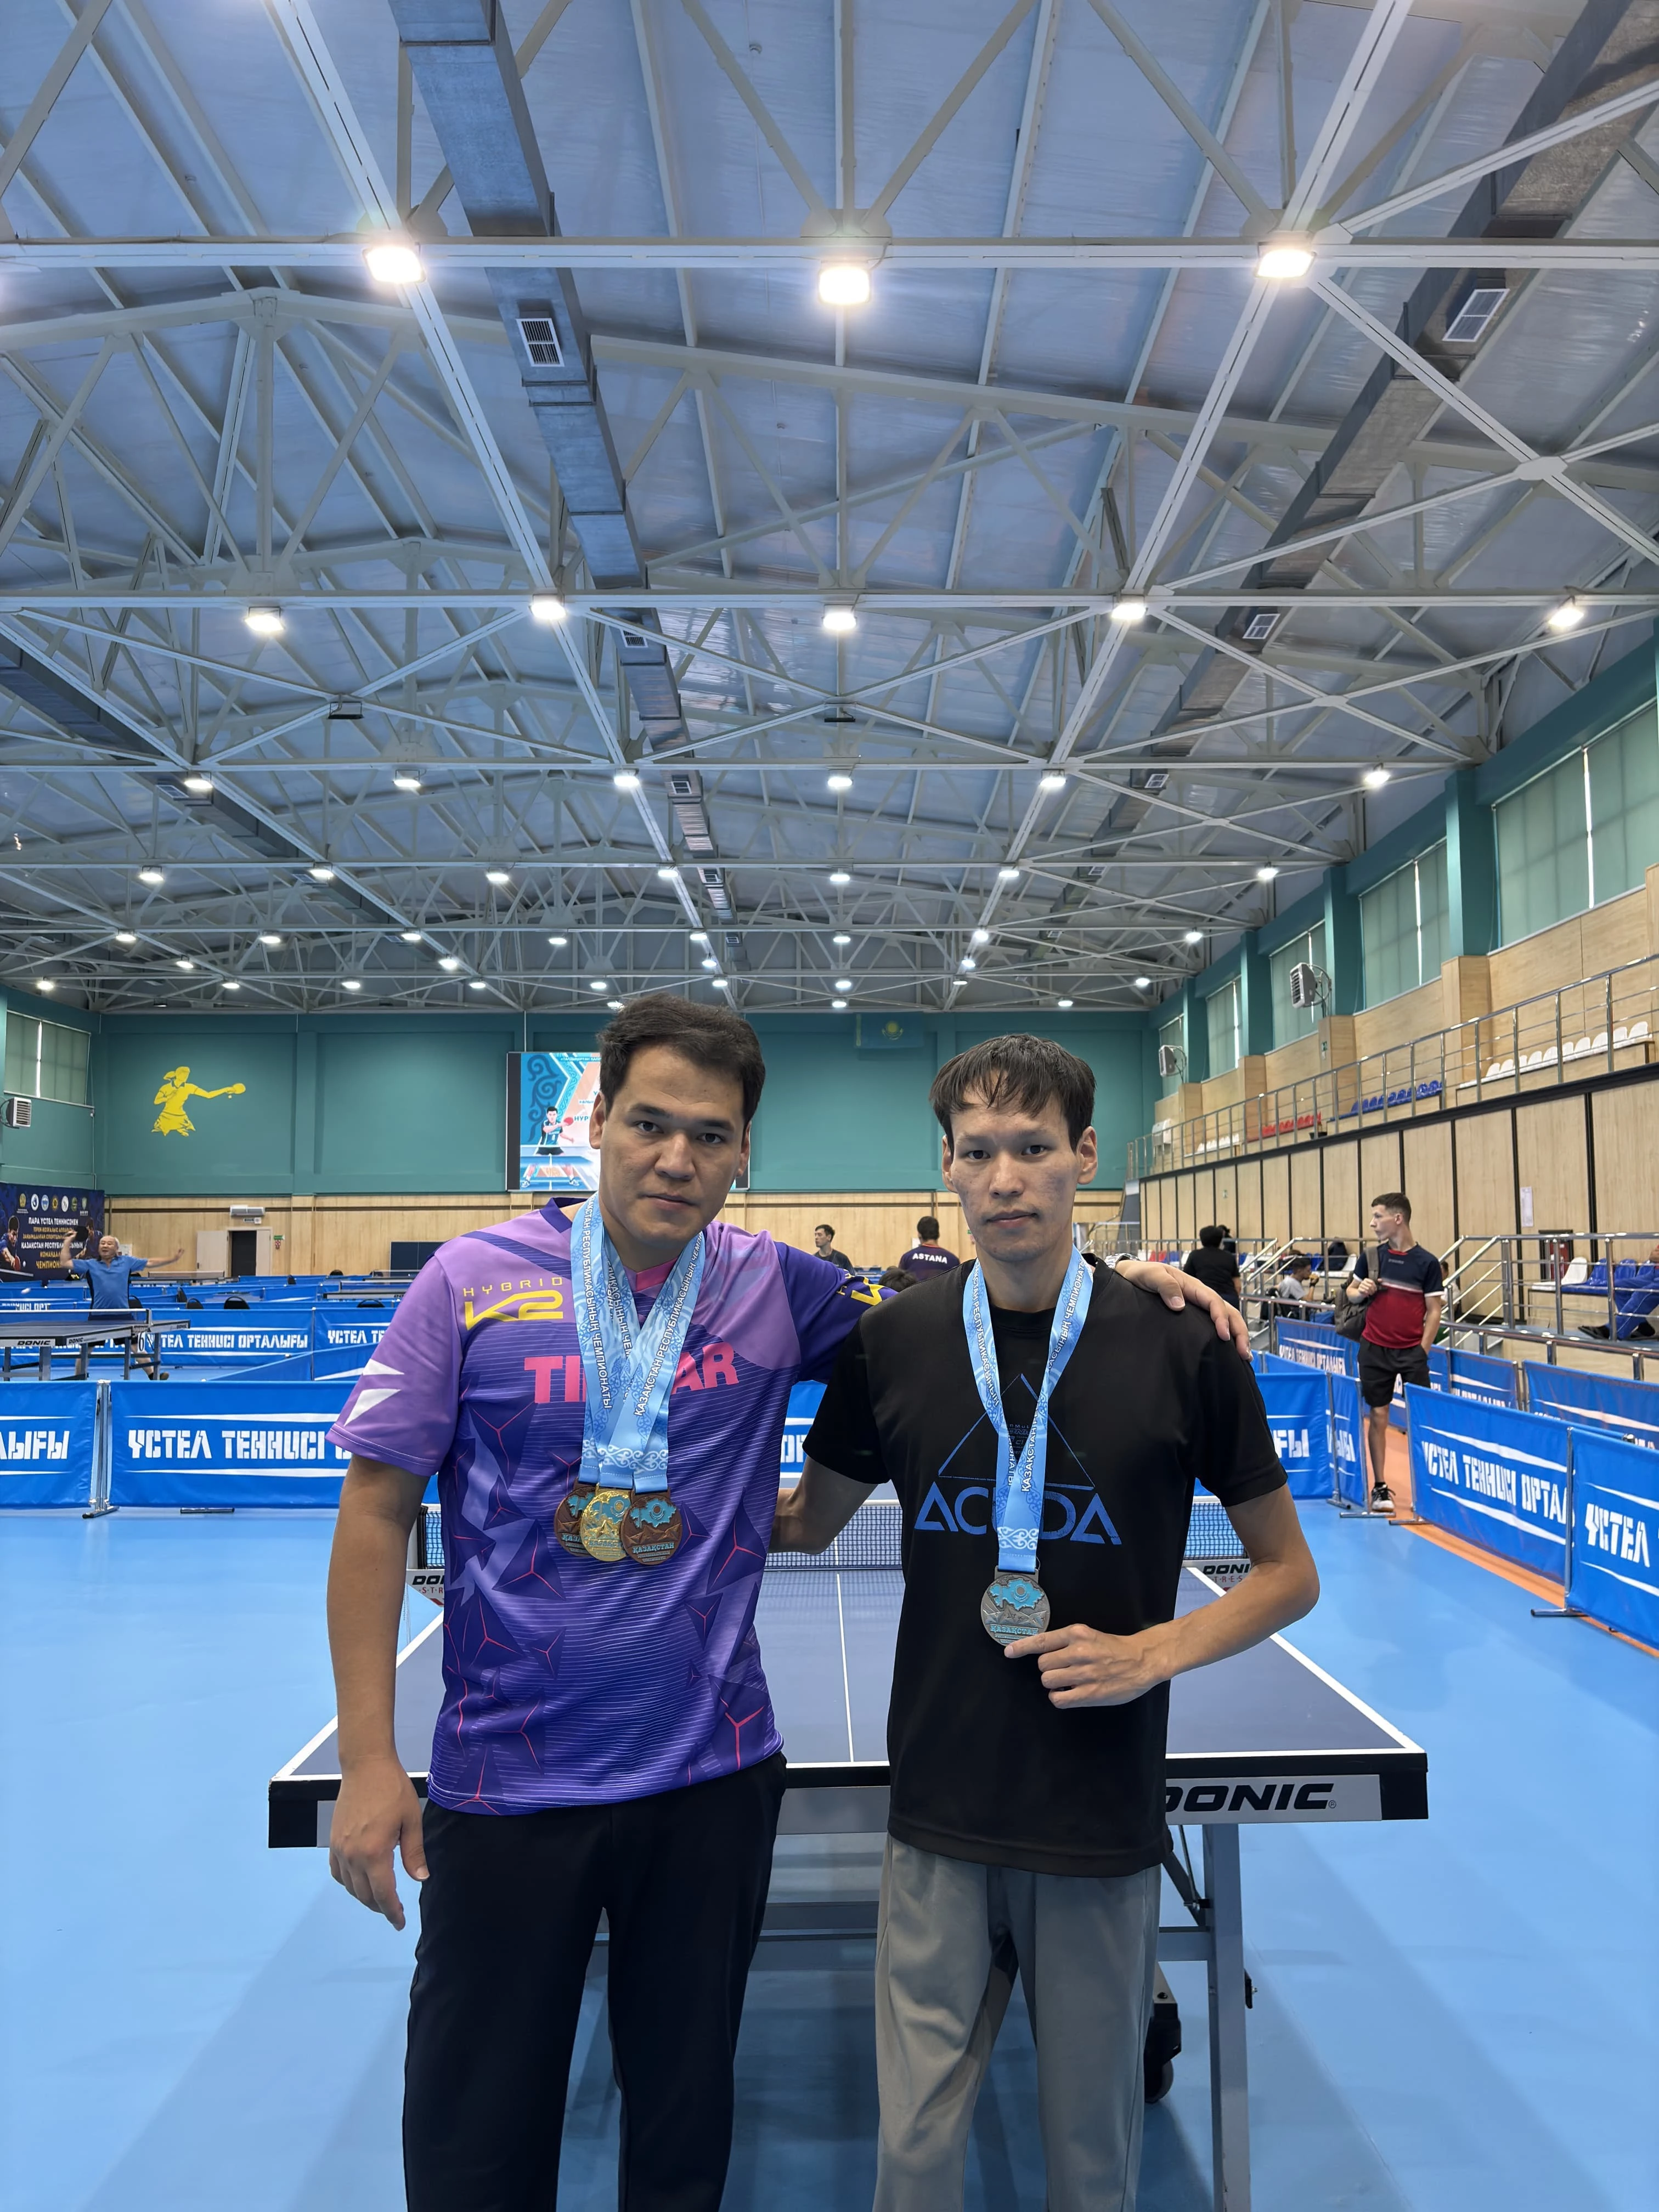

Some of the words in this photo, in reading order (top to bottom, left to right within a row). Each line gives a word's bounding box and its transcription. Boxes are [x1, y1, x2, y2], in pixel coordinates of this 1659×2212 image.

[36, 1261, 60, 1269] ЧЕМПИОН
[912, 1253, 947, 1264] ASTANA
[463, 1277, 562, 1296] HYBRID
[465, 1290, 563, 1330] K2
[187, 1334, 234, 1348] ТЕННИСІ
[238, 1334, 308, 1348] ОРТАЛЫҒЫ
[634, 1358, 663, 1417] ҚАЗАҚСТАН
[658, 1262, 697, 1358] РЕСПУБЛИКАСЫНЫҢ
[524, 1342, 740, 1404] TIAR
[592, 1332, 612, 1409] ЧЕМПИОНАТЫ
[222, 1430, 325, 1460] ТЕННИСІ
[1021, 1427, 1036, 1492] ҚАЗАҚСТАН
[1463, 1454, 1516, 1506] ТЕННИСІ
[913, 1481, 1122, 1545] ACDA
[632, 1542, 675, 1554] ҚАЗАҚСТАН
[1203, 1564, 1250, 1575] DONI
